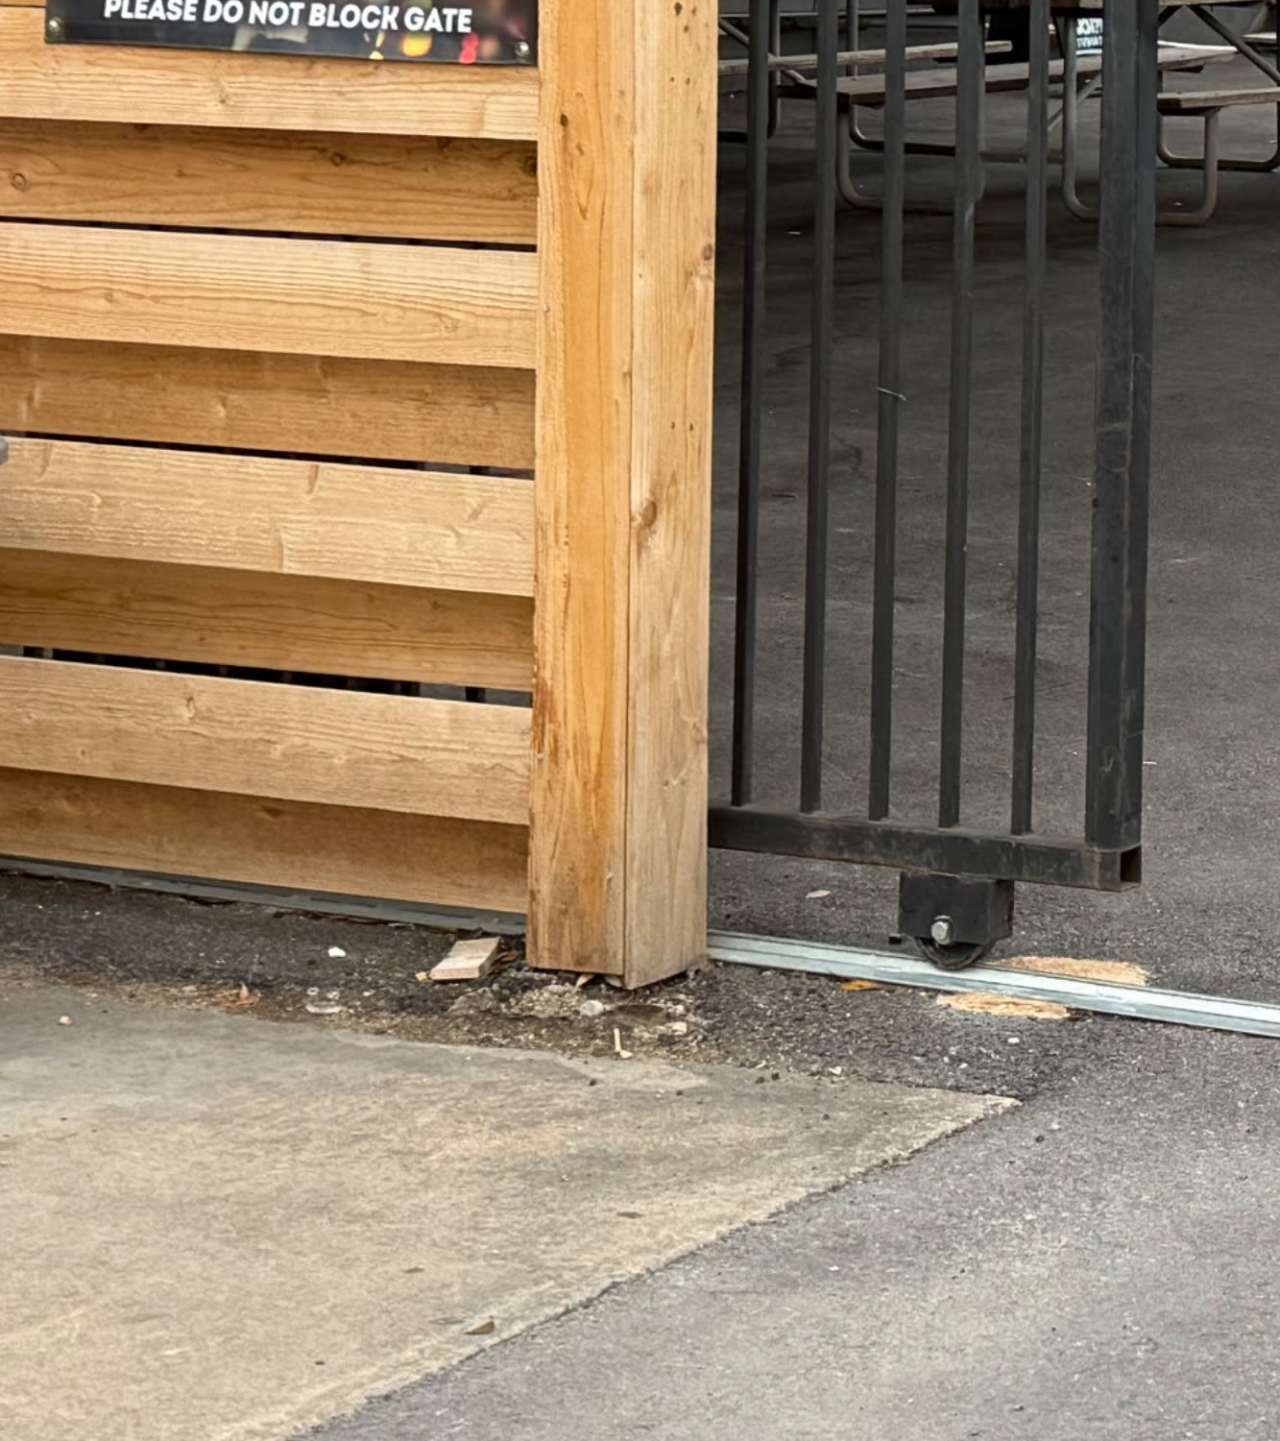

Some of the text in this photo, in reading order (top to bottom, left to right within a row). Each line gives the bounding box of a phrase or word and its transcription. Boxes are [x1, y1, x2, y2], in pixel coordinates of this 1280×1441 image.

[203, 0, 244, 24] DO
[249, 1, 305, 27] NOT
[309, 3, 399, 31] BLOCK
[404, 7, 473, 34] GATE
